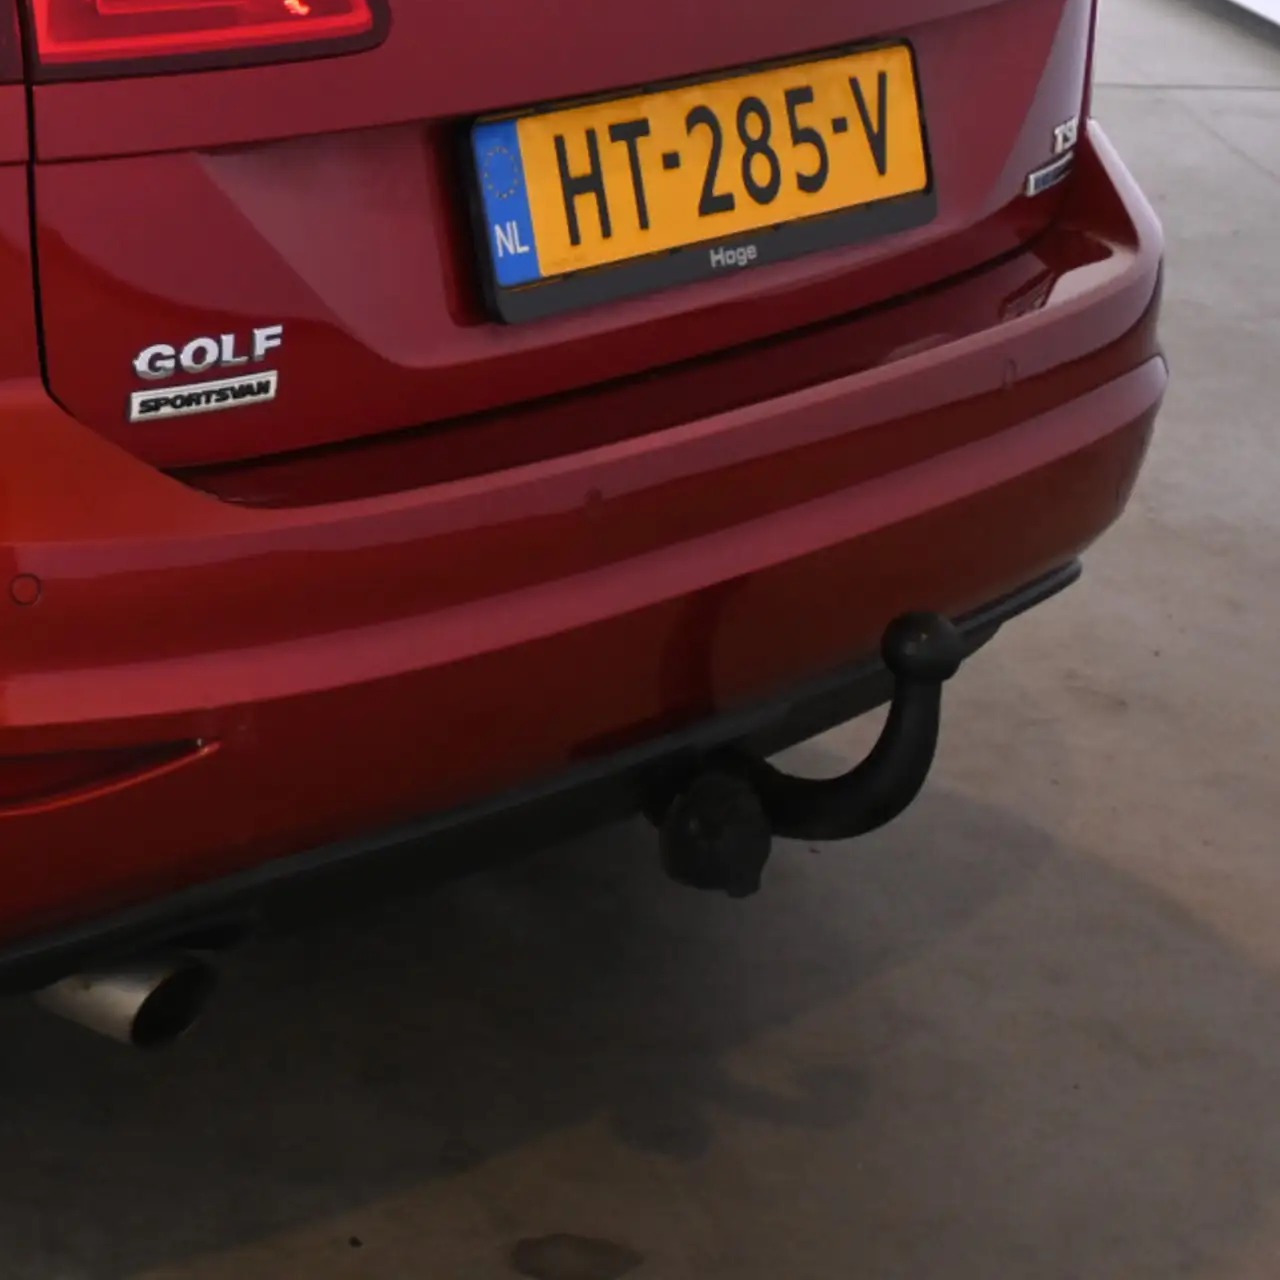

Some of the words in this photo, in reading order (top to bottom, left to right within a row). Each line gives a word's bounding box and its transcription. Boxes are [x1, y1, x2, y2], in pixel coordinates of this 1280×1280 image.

[553, 70, 888, 246] HT-285-V
[493, 220, 529, 258] NL
[709, 244, 758, 269] Hoge
[132, 324, 283, 381] GOLF
[138, 379, 271, 415] SPORTSVAN
